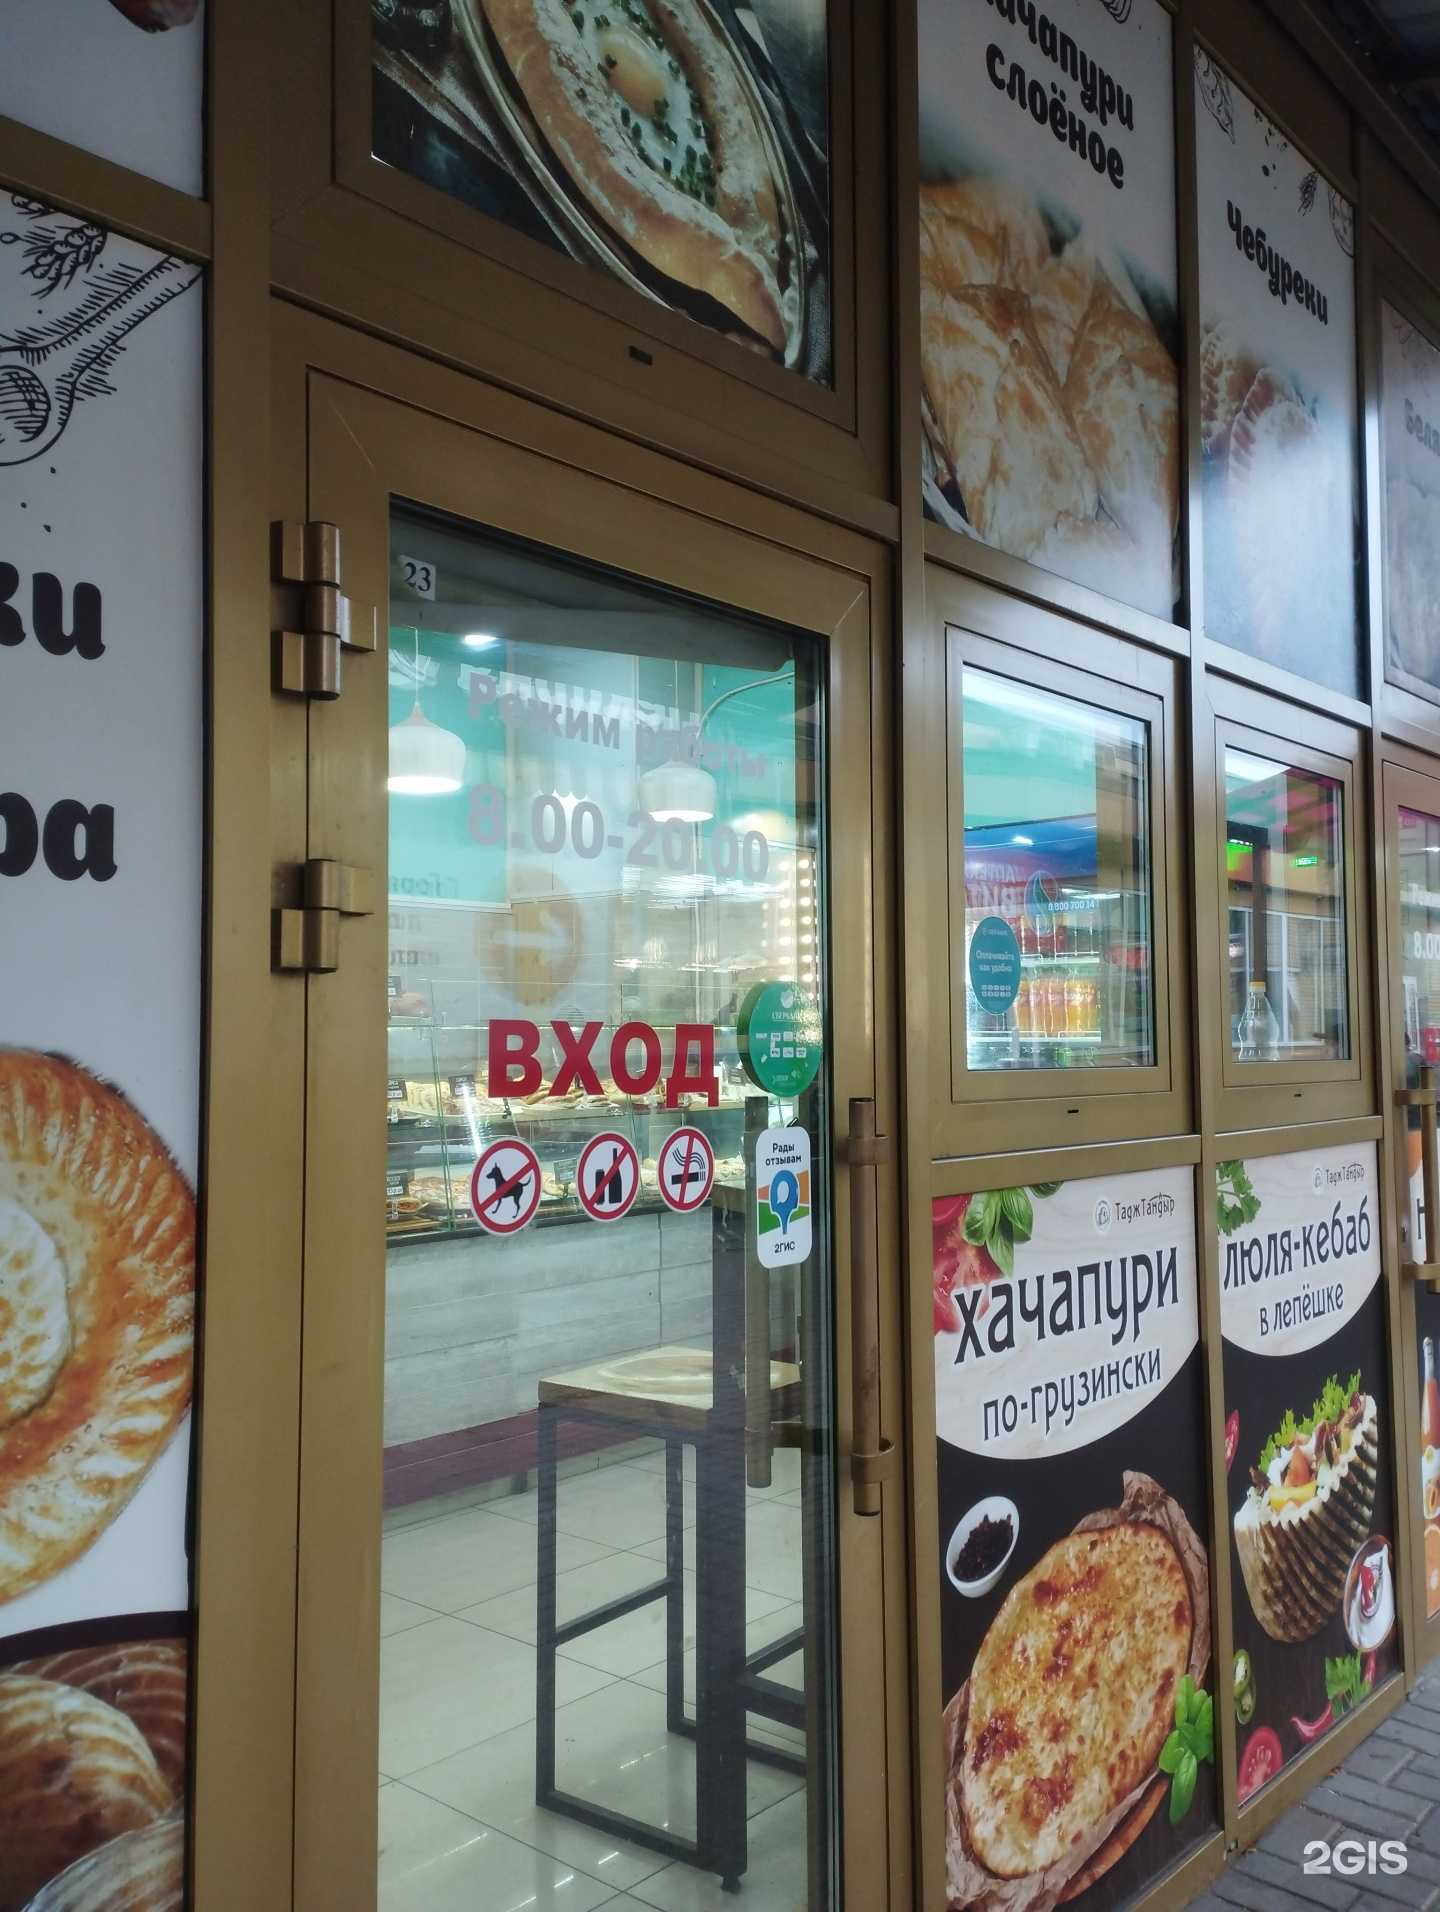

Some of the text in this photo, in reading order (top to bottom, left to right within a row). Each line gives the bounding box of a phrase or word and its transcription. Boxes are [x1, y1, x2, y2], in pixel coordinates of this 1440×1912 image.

[986, 0, 1134, 131] ачапури
[986, 43, 1124, 190] слоёное
[404, 562, 431, 591] 23
[469, 672, 621, 750] Режим
[468, 783, 769, 883] 8.00-20.00
[488, 1018, 720, 1108] ВХОД
[765, 1155, 802, 1166] отзывам
[772, 1143, 795, 1154] Рады
[774, 1241, 796, 1254] 2ГИС
[1223, 1195, 1371, 1290] люля-кебаб
[953, 1247, 1179, 1365] хачапури
[1259, 1283, 1344, 1337] в лепёшке
[983, 1348, 1162, 1441] по-грузински
